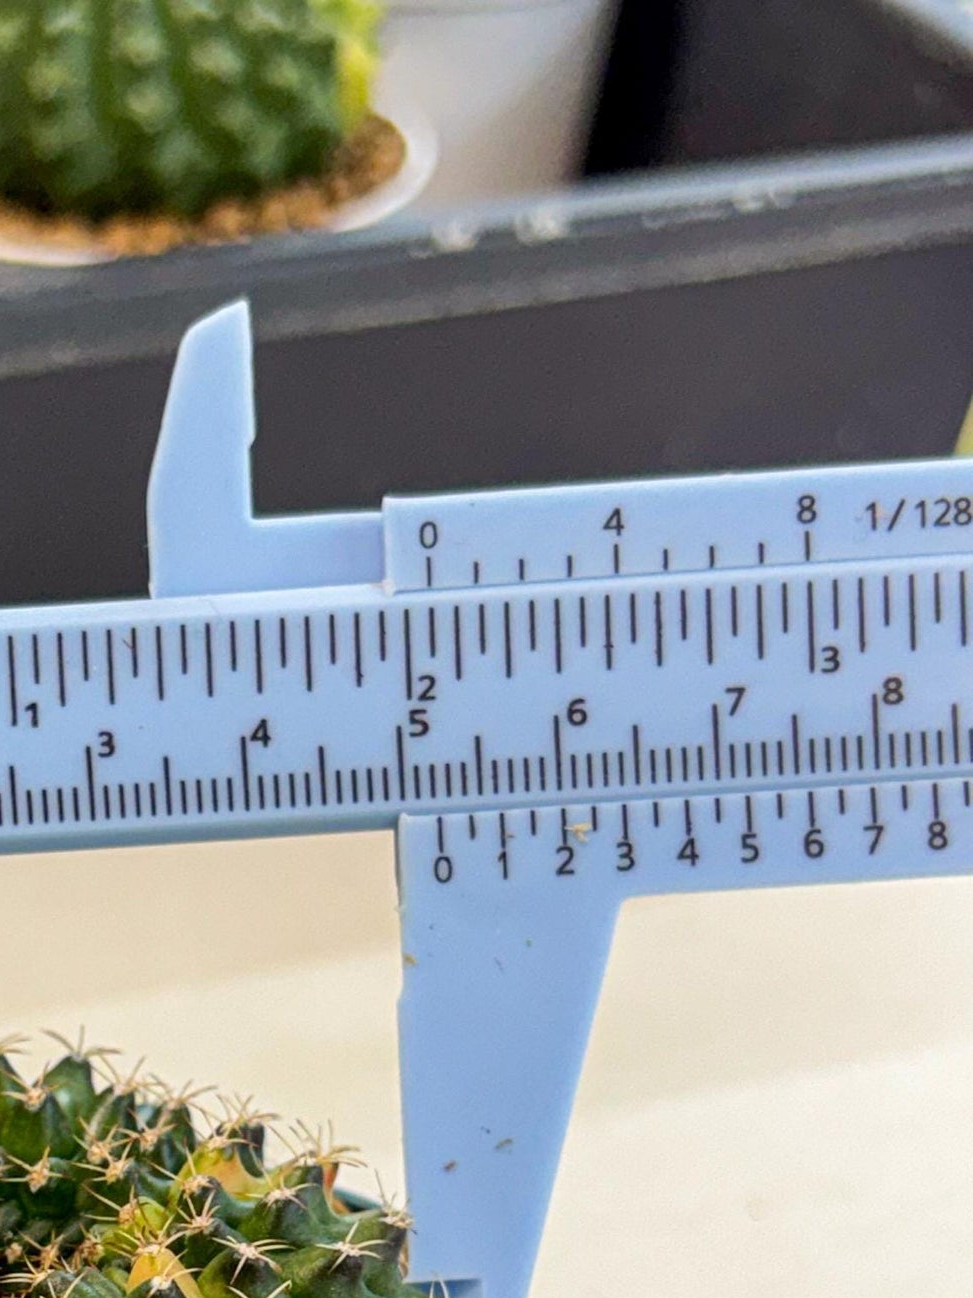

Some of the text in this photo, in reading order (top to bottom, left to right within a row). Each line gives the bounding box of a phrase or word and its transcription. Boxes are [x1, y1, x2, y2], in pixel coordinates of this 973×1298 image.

[418, 494, 973, 550] 0 4 8 1/128
[24, 702, 39, 728] 1
[417, 674, 436, 701] 2
[821, 645, 841, 673] 3
[97, 730, 116, 759] 3
[249, 718, 272, 748] 4
[408, 708, 430, 738] 5
[566, 697, 588, 727] 6
[725, 686, 746, 717] 7
[881, 676, 904, 706] 8
[433, 820, 948, 884] 0 1 2 3 4 5 6 7 8
